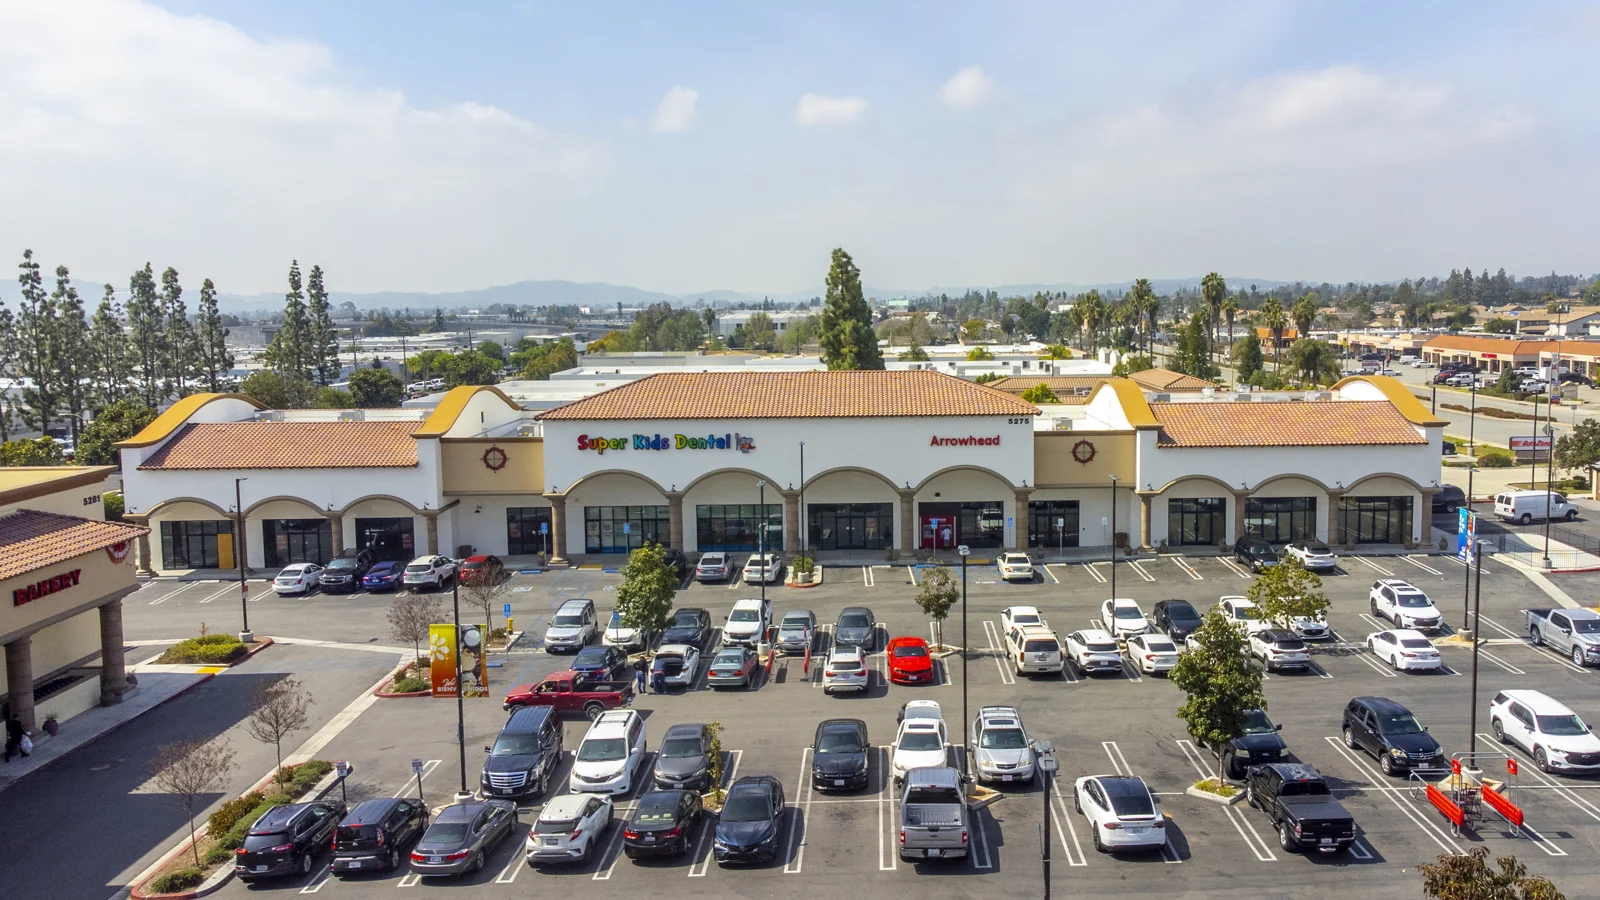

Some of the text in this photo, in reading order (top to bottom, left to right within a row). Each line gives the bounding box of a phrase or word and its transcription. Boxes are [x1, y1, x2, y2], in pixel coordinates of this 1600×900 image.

[577, 433, 731, 455] Super Kids Dental
[930, 435, 1000, 447] Arrowhead
[83, 494, 101, 506] 5281
[13, 569, 82, 607] BAKERY
